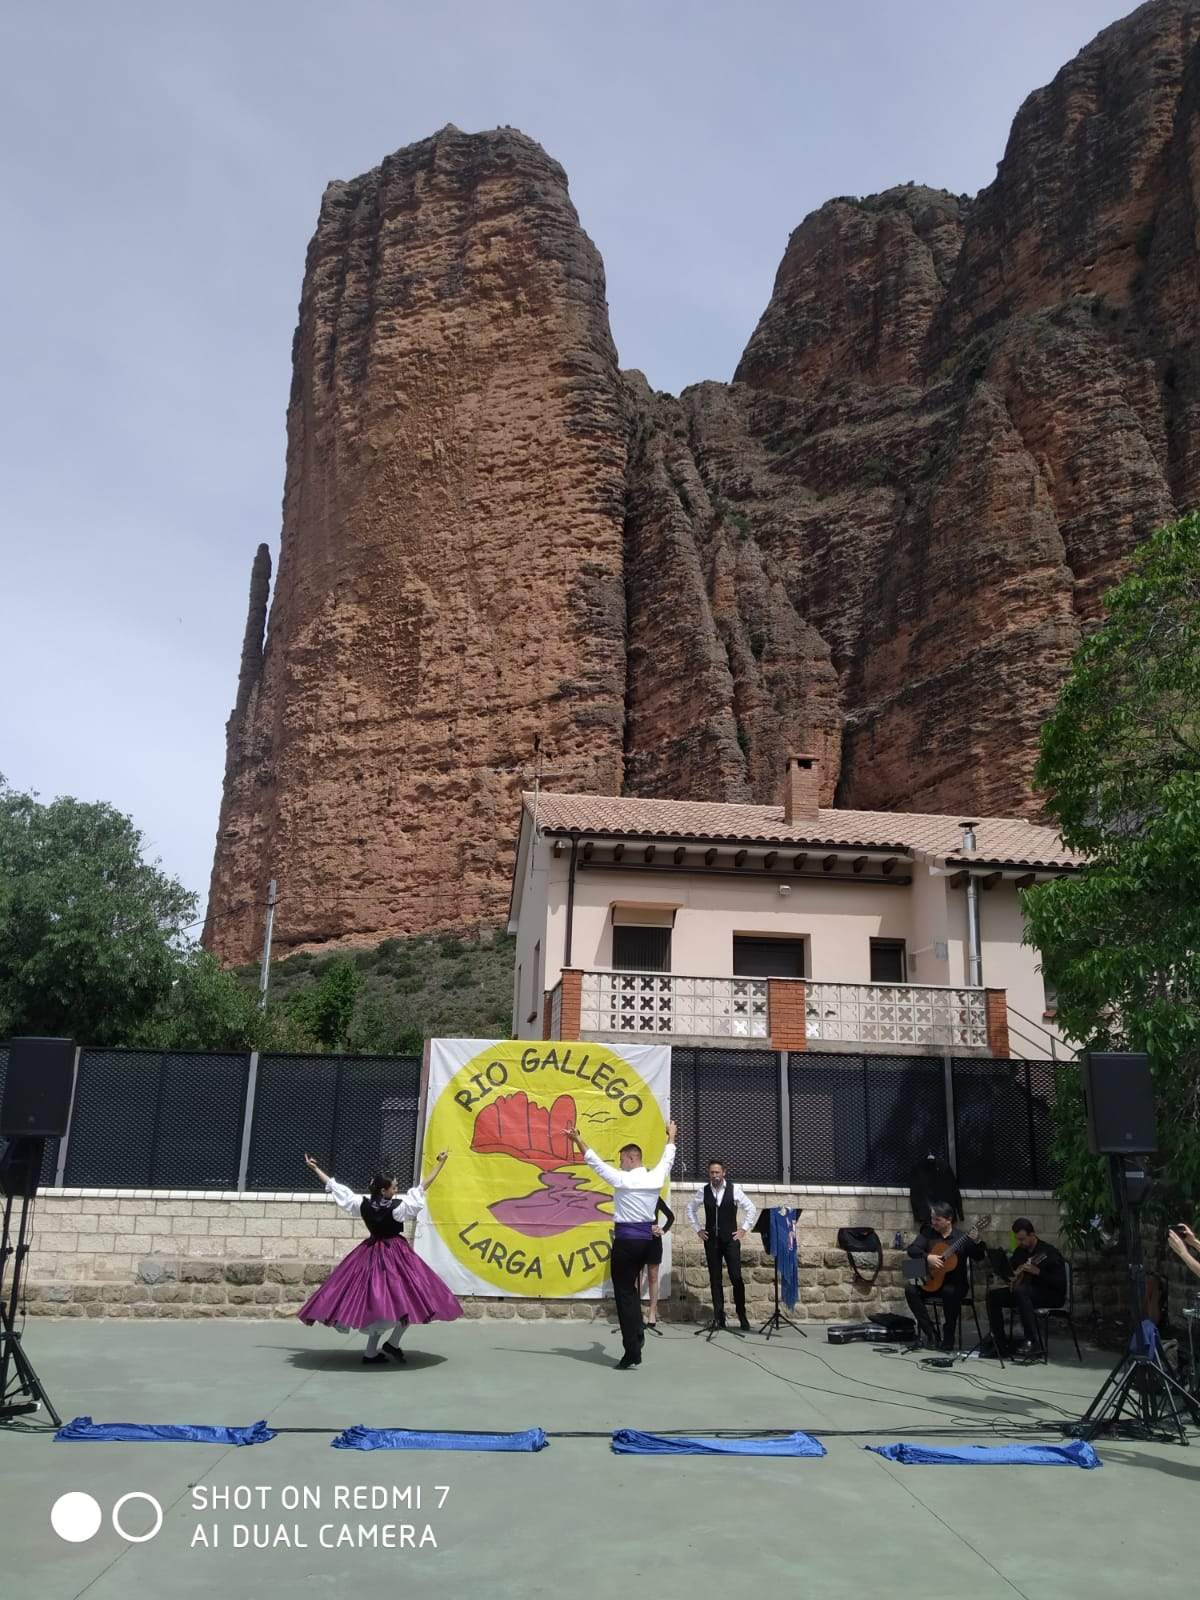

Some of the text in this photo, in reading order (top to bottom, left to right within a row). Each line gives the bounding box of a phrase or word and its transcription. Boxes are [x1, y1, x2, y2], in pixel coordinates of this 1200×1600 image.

[453, 1047, 643, 1117] RIO GALLEGO
[458, 1221, 616, 1280] LARGA VID
